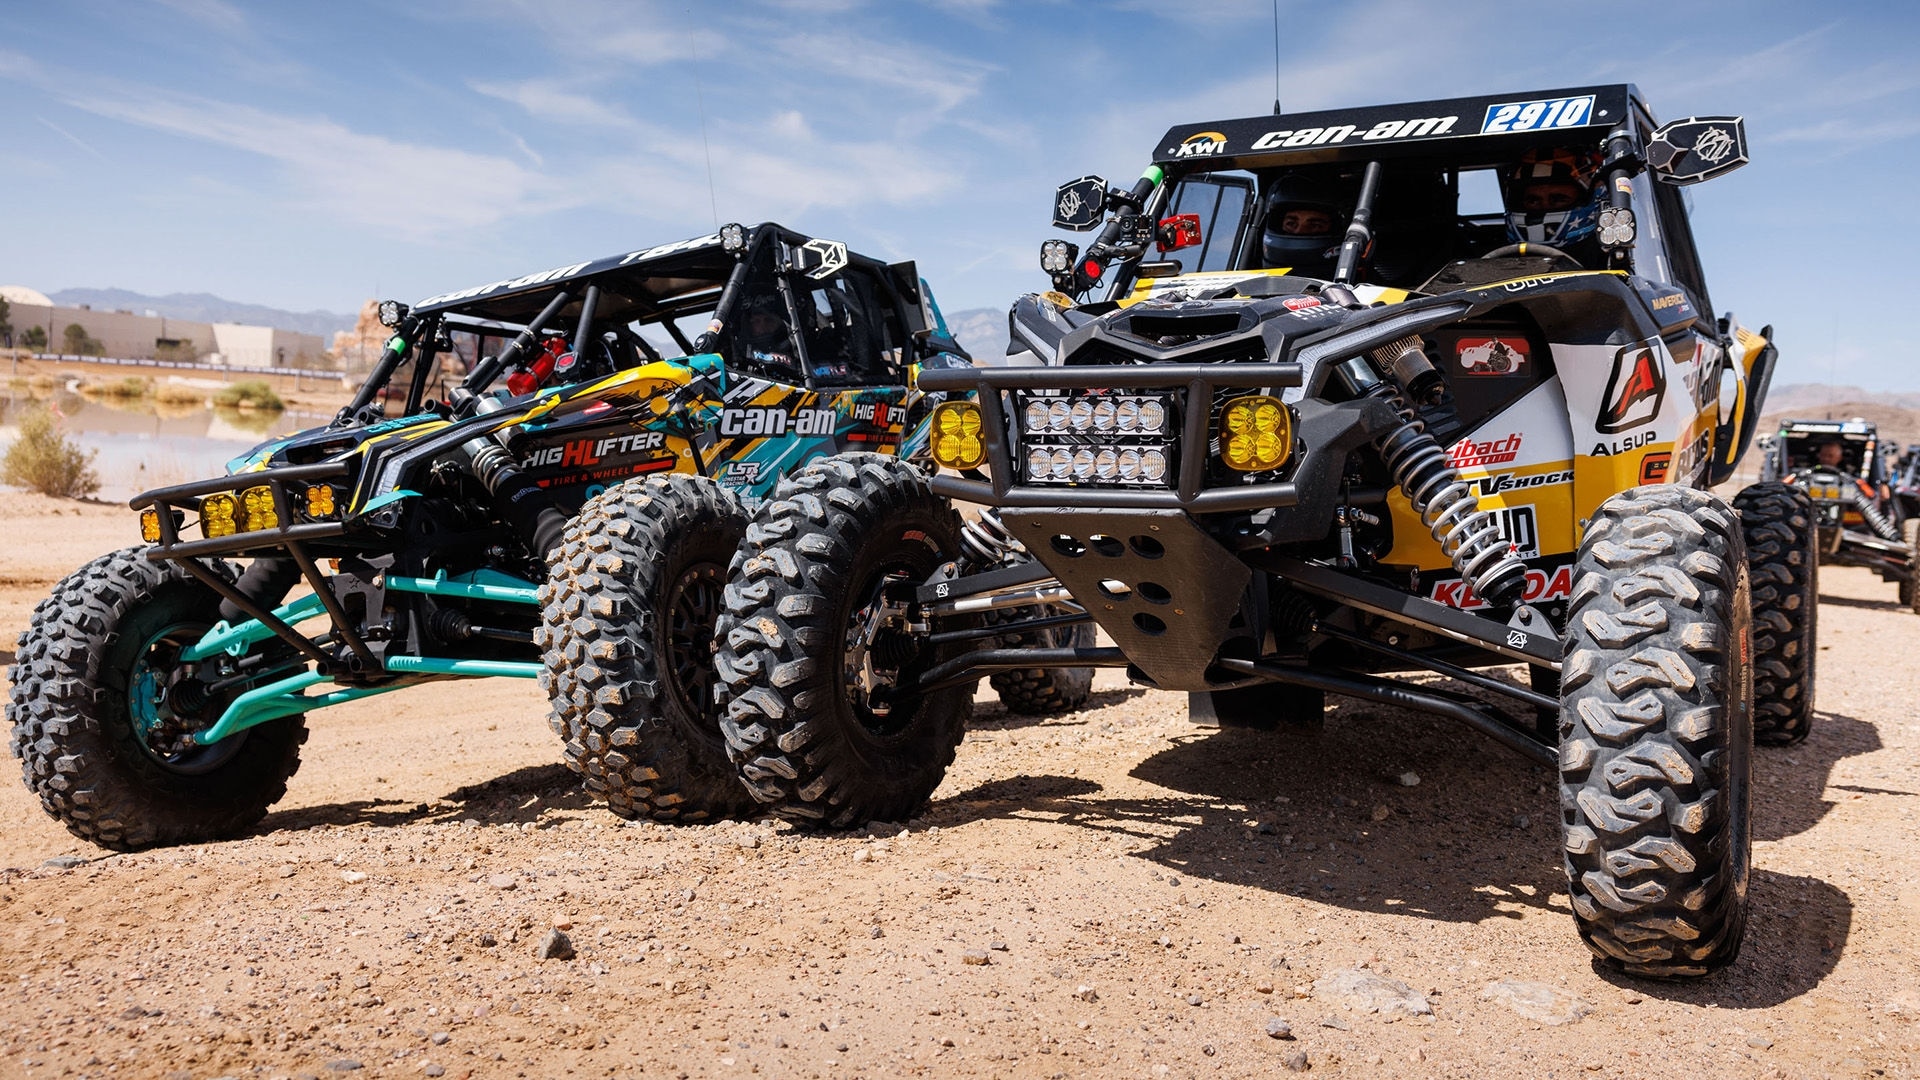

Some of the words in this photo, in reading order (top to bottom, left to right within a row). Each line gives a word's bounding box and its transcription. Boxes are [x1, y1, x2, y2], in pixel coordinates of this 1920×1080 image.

[1484, 97, 1591, 133] 2910
[1251, 115, 1459, 149] can-am
[720, 408, 837, 435] can-am
[521, 432, 665, 469] HIGHLIFTER
[1590, 431, 1657, 456] ALSUP
[553, 475, 577, 486] TIRE
[581, 473, 588, 482] &
[593, 467, 630, 479] WHEEL
[728, 462, 760, 475] LSR
[1433, 568, 1571, 608] KEDA
